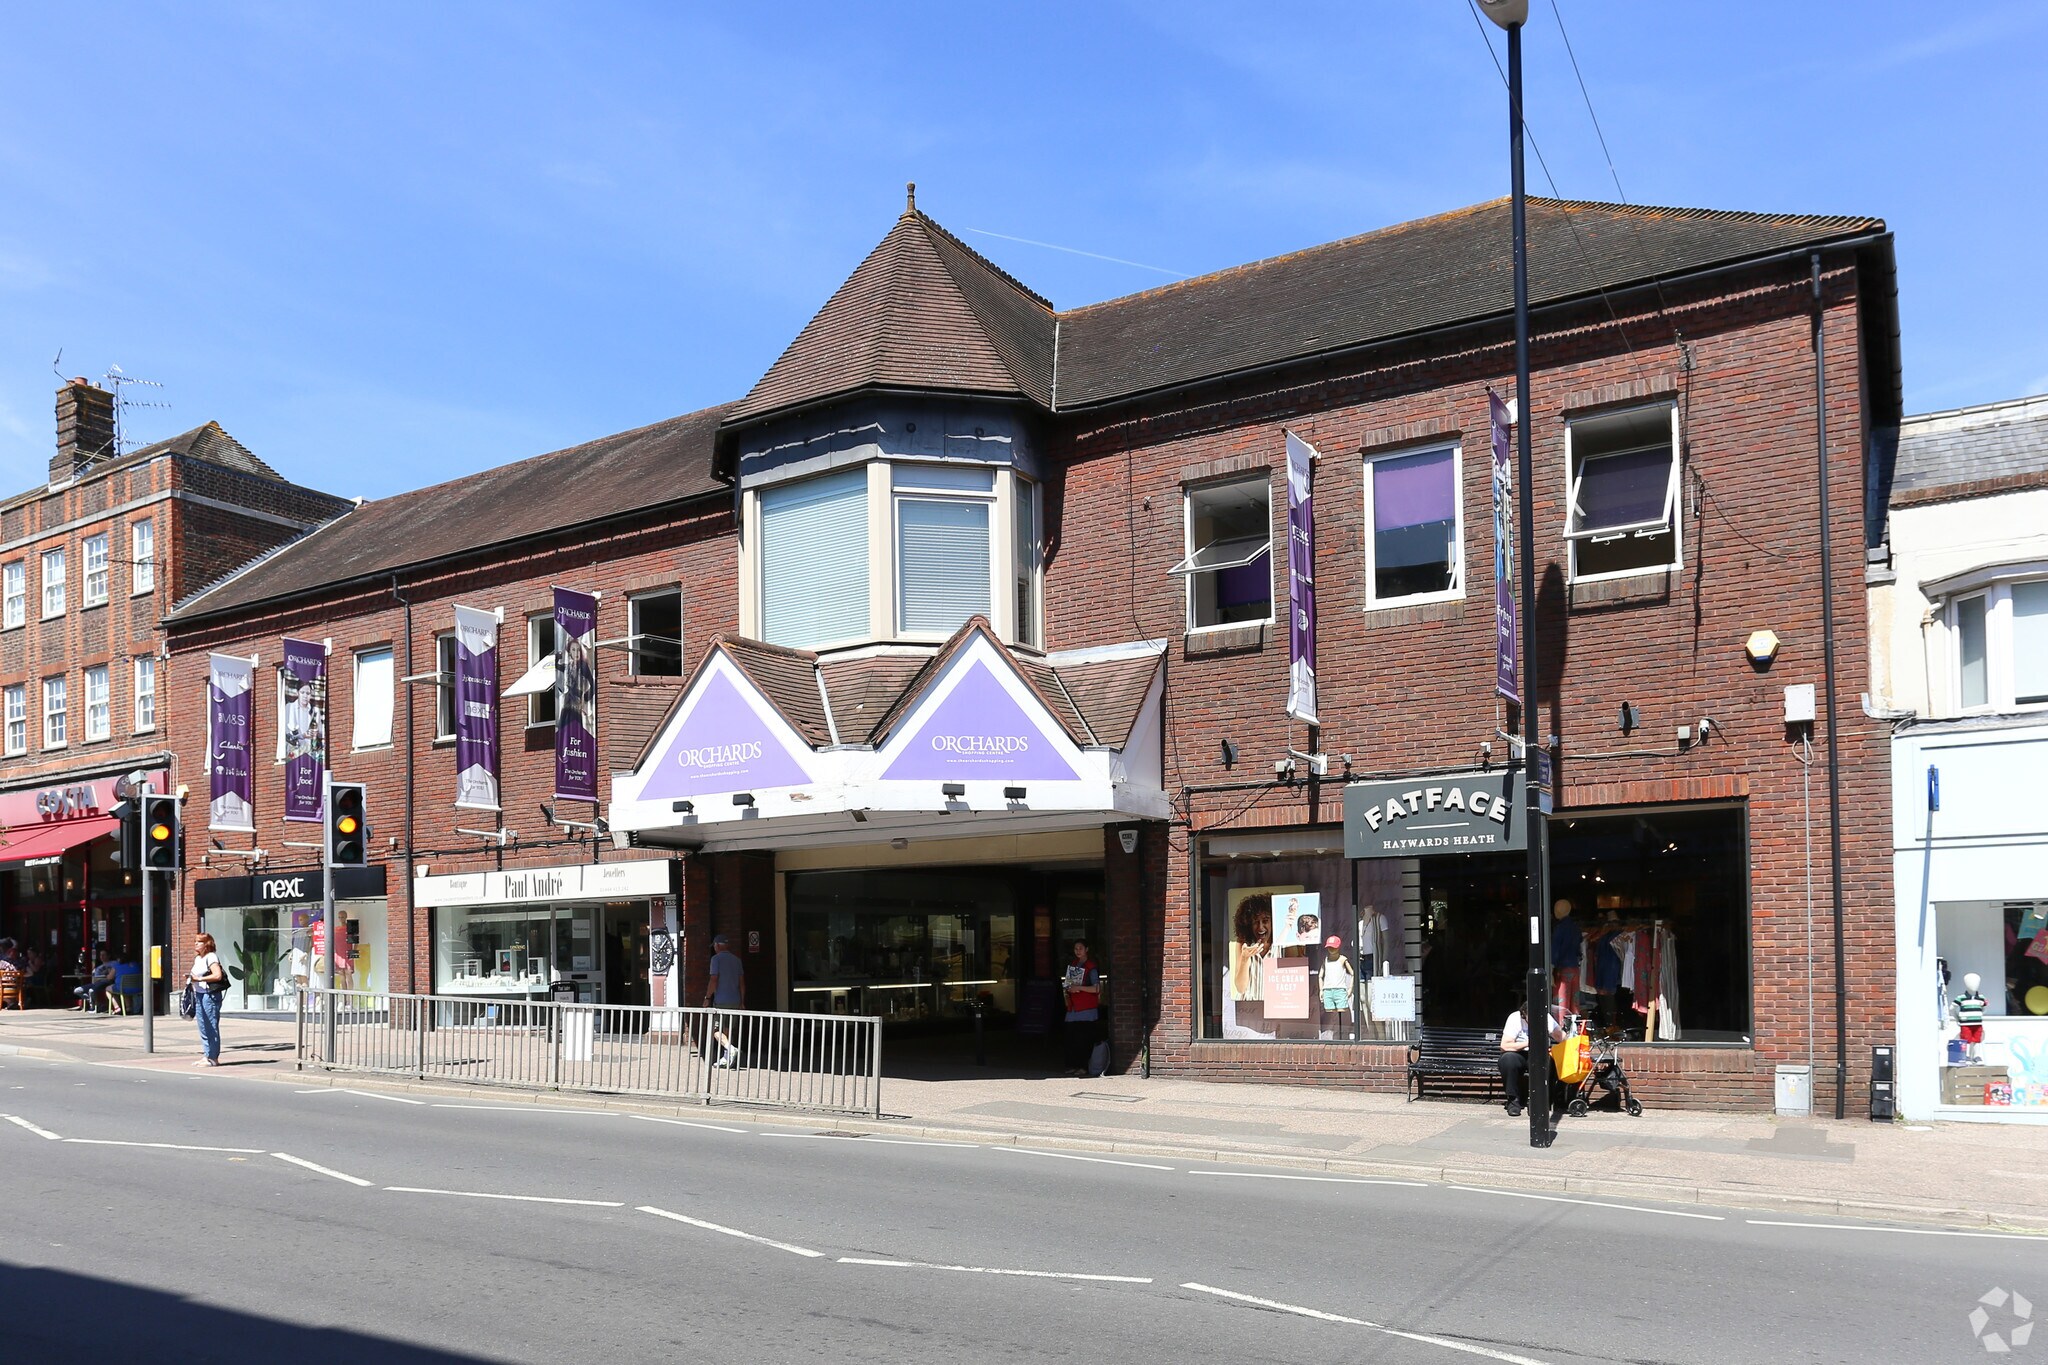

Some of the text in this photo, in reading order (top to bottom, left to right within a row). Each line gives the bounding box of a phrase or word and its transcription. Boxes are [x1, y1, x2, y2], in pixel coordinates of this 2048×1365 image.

[558, 606, 591, 619] ORCHARDS
[288, 654, 322, 667] ORCHARDS
[222, 714, 246, 727] M&S
[570, 736, 582, 746] For
[931, 735, 1029, 754] ORCHARDS
[562, 747, 588, 759] fashion
[678, 741, 762, 767] ORCHARDS
[300, 767, 312, 775] For
[36, 785, 99, 815] COSTA
[1363, 787, 1512, 832] FATFACE
[1382, 834, 1496, 849] HAYWARDS HEATH
[603, 867, 626, 878] Jewellers
[262, 877, 304, 899] next
[504, 871, 563, 899] Paul André
[1276, 983, 1297, 991] FACE?
